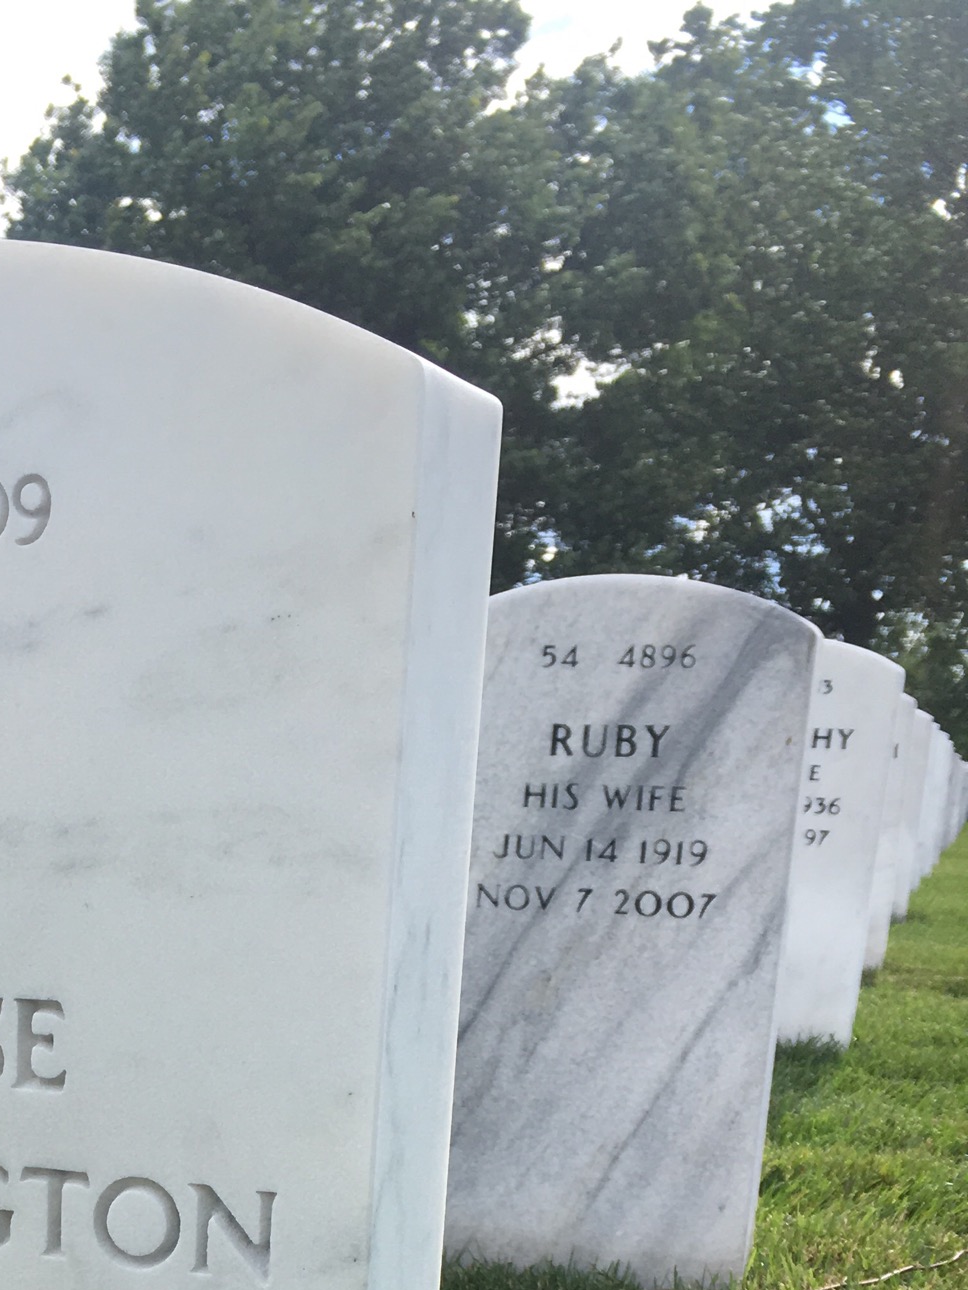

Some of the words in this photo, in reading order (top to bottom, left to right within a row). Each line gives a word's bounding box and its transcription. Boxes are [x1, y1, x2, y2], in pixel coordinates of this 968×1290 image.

[541, 644, 579, 668] 54
[617, 644, 697, 669] 4896
[549, 723, 671, 758] RUBY
[522, 783, 579, 810] HIS
[603, 785, 687, 812] WIFE
[493, 833, 566, 861] JUN
[585, 837, 618, 863] 14
[639, 838, 709, 867] 1919
[475, 883, 557, 911] NOV
[576, 888, 594, 913] 7
[614, 889, 718, 919] 2007
